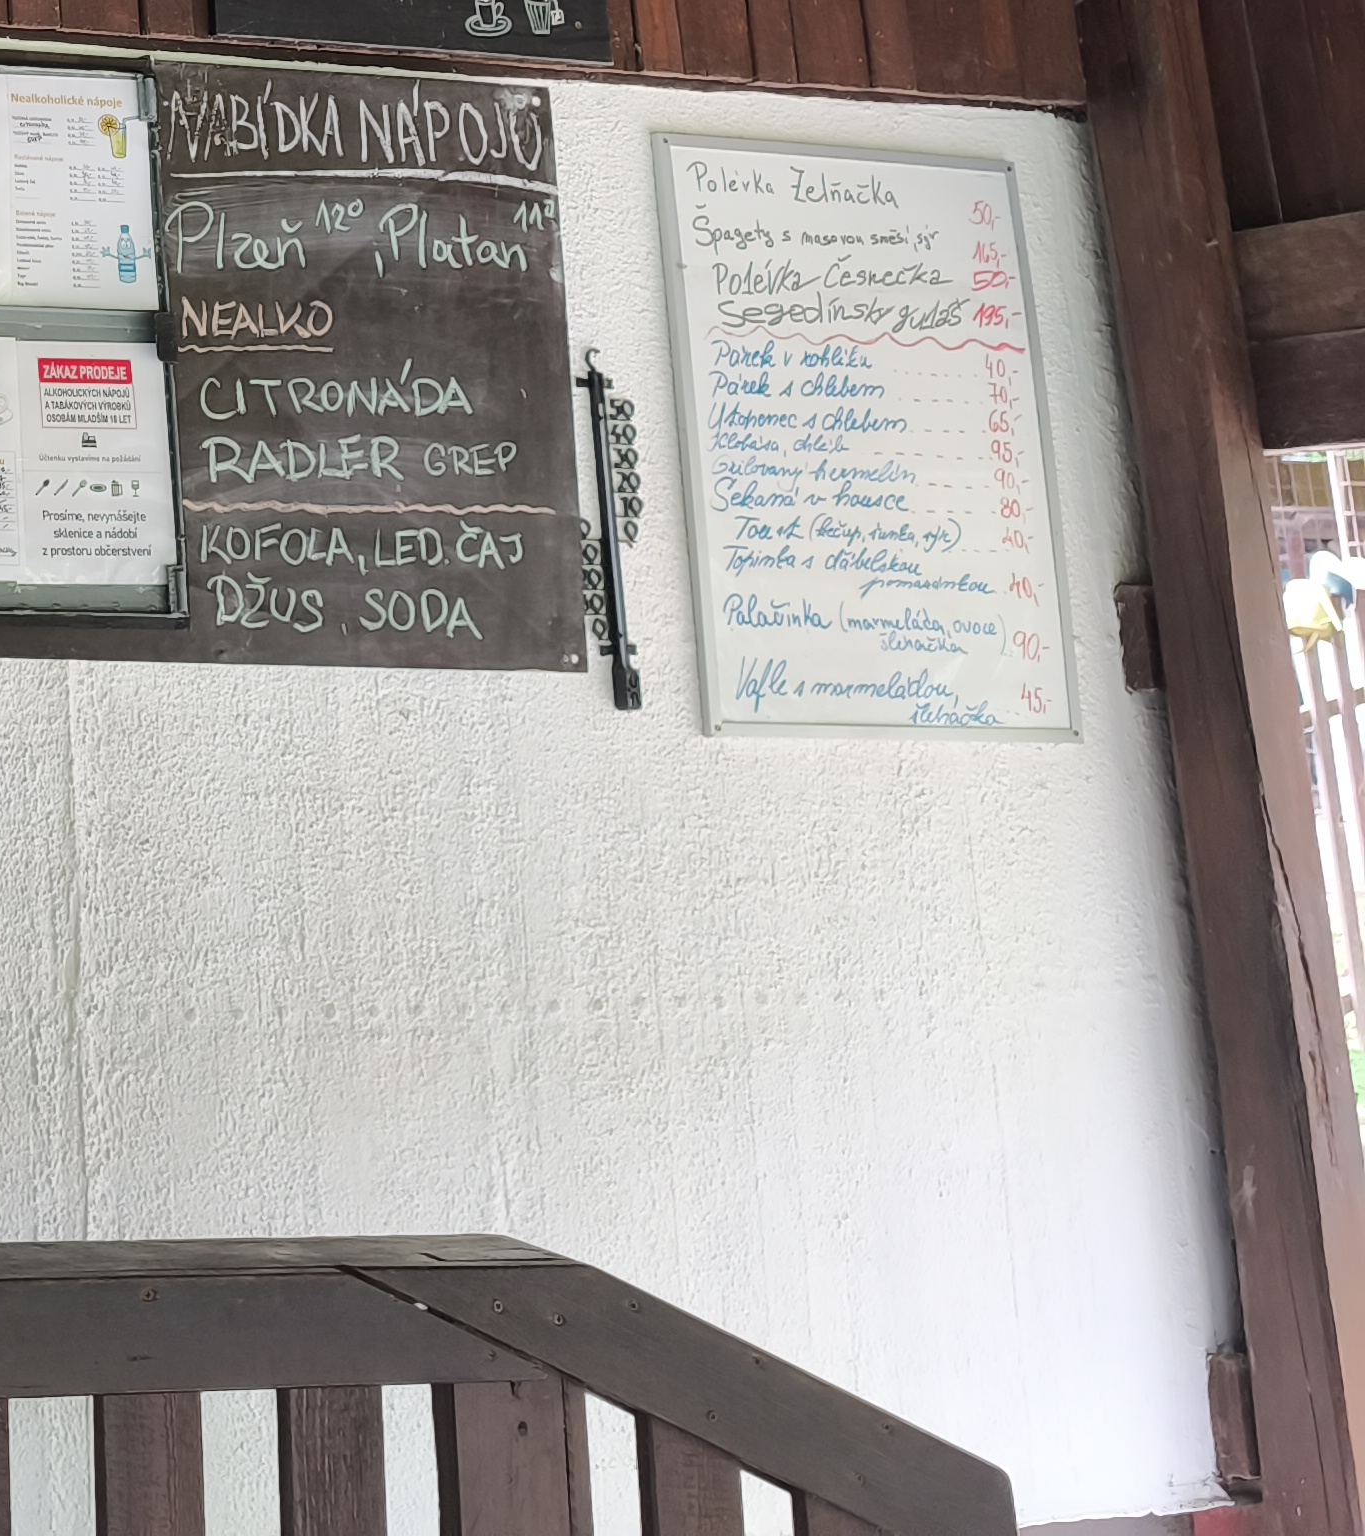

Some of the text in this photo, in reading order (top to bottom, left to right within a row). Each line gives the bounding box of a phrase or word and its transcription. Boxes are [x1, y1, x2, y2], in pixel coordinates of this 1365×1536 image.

[11, 93, 122, 109] Nealkoholické nápoje
[167, 78, 345, 162] NABÍDKA
[165, 200, 306, 274] Plzeň
[824, 254, 954, 288] Česnečka
[971, 270, 1016, 291] 50,-
[181, 296, 334, 340] NEALKO
[43, 361, 127, 380] ZÁKAZ PRODEJE
[44, 387, 129, 398] ALKOHOLICKÝCH NÁPOJŮ
[199, 358, 473, 421] CITRONÁDA
[51, 399, 97, 410] TABÁKOVÝCH
[119, 415, 131, 424] LET
[199, 434, 518, 484] RADLER GREP
[42, 509, 146, 524] Prosíme, nevynášejte
[54, 528, 93, 539] sklenice
[105, 527, 137, 539] nádobí
[42, 544, 151, 558] z prostoru občerstvení
[200, 522, 369, 576] KOFOLA,
[455, 521, 524, 570] ČAJ
[359, 588, 484, 641] SODA
